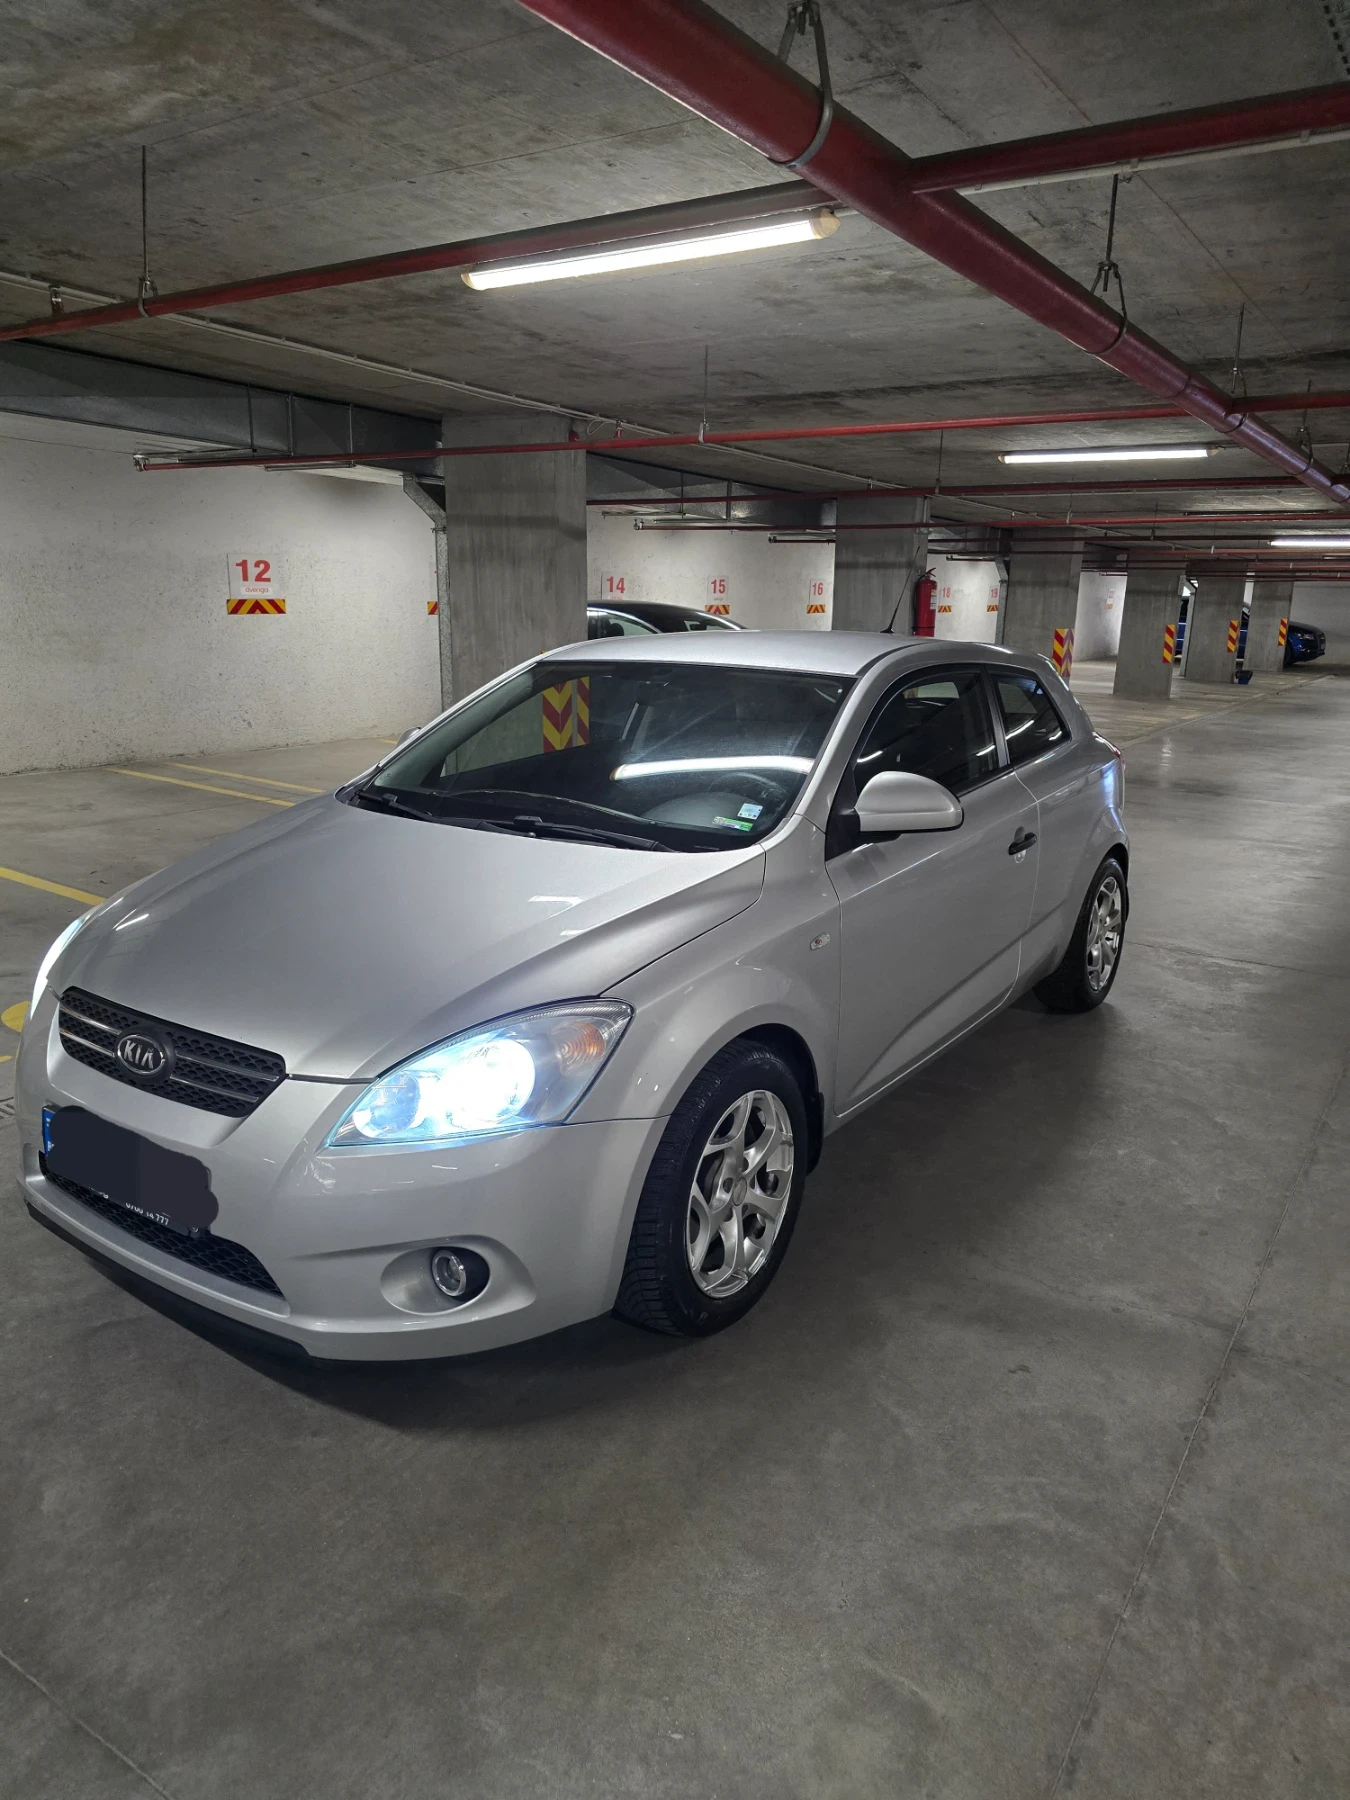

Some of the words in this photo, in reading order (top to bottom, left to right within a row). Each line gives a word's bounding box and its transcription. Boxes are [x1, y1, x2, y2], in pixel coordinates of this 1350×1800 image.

[235, 559, 271, 582] 12
[244, 587, 269, 595] avenga
[606, 576, 625, 594] 14
[710, 579, 726, 594] 15
[812, 582, 824, 595] 16
[942, 587, 951, 598] 18
[990, 588, 998, 598] 19
[123, 1039, 155, 1069] KIA
